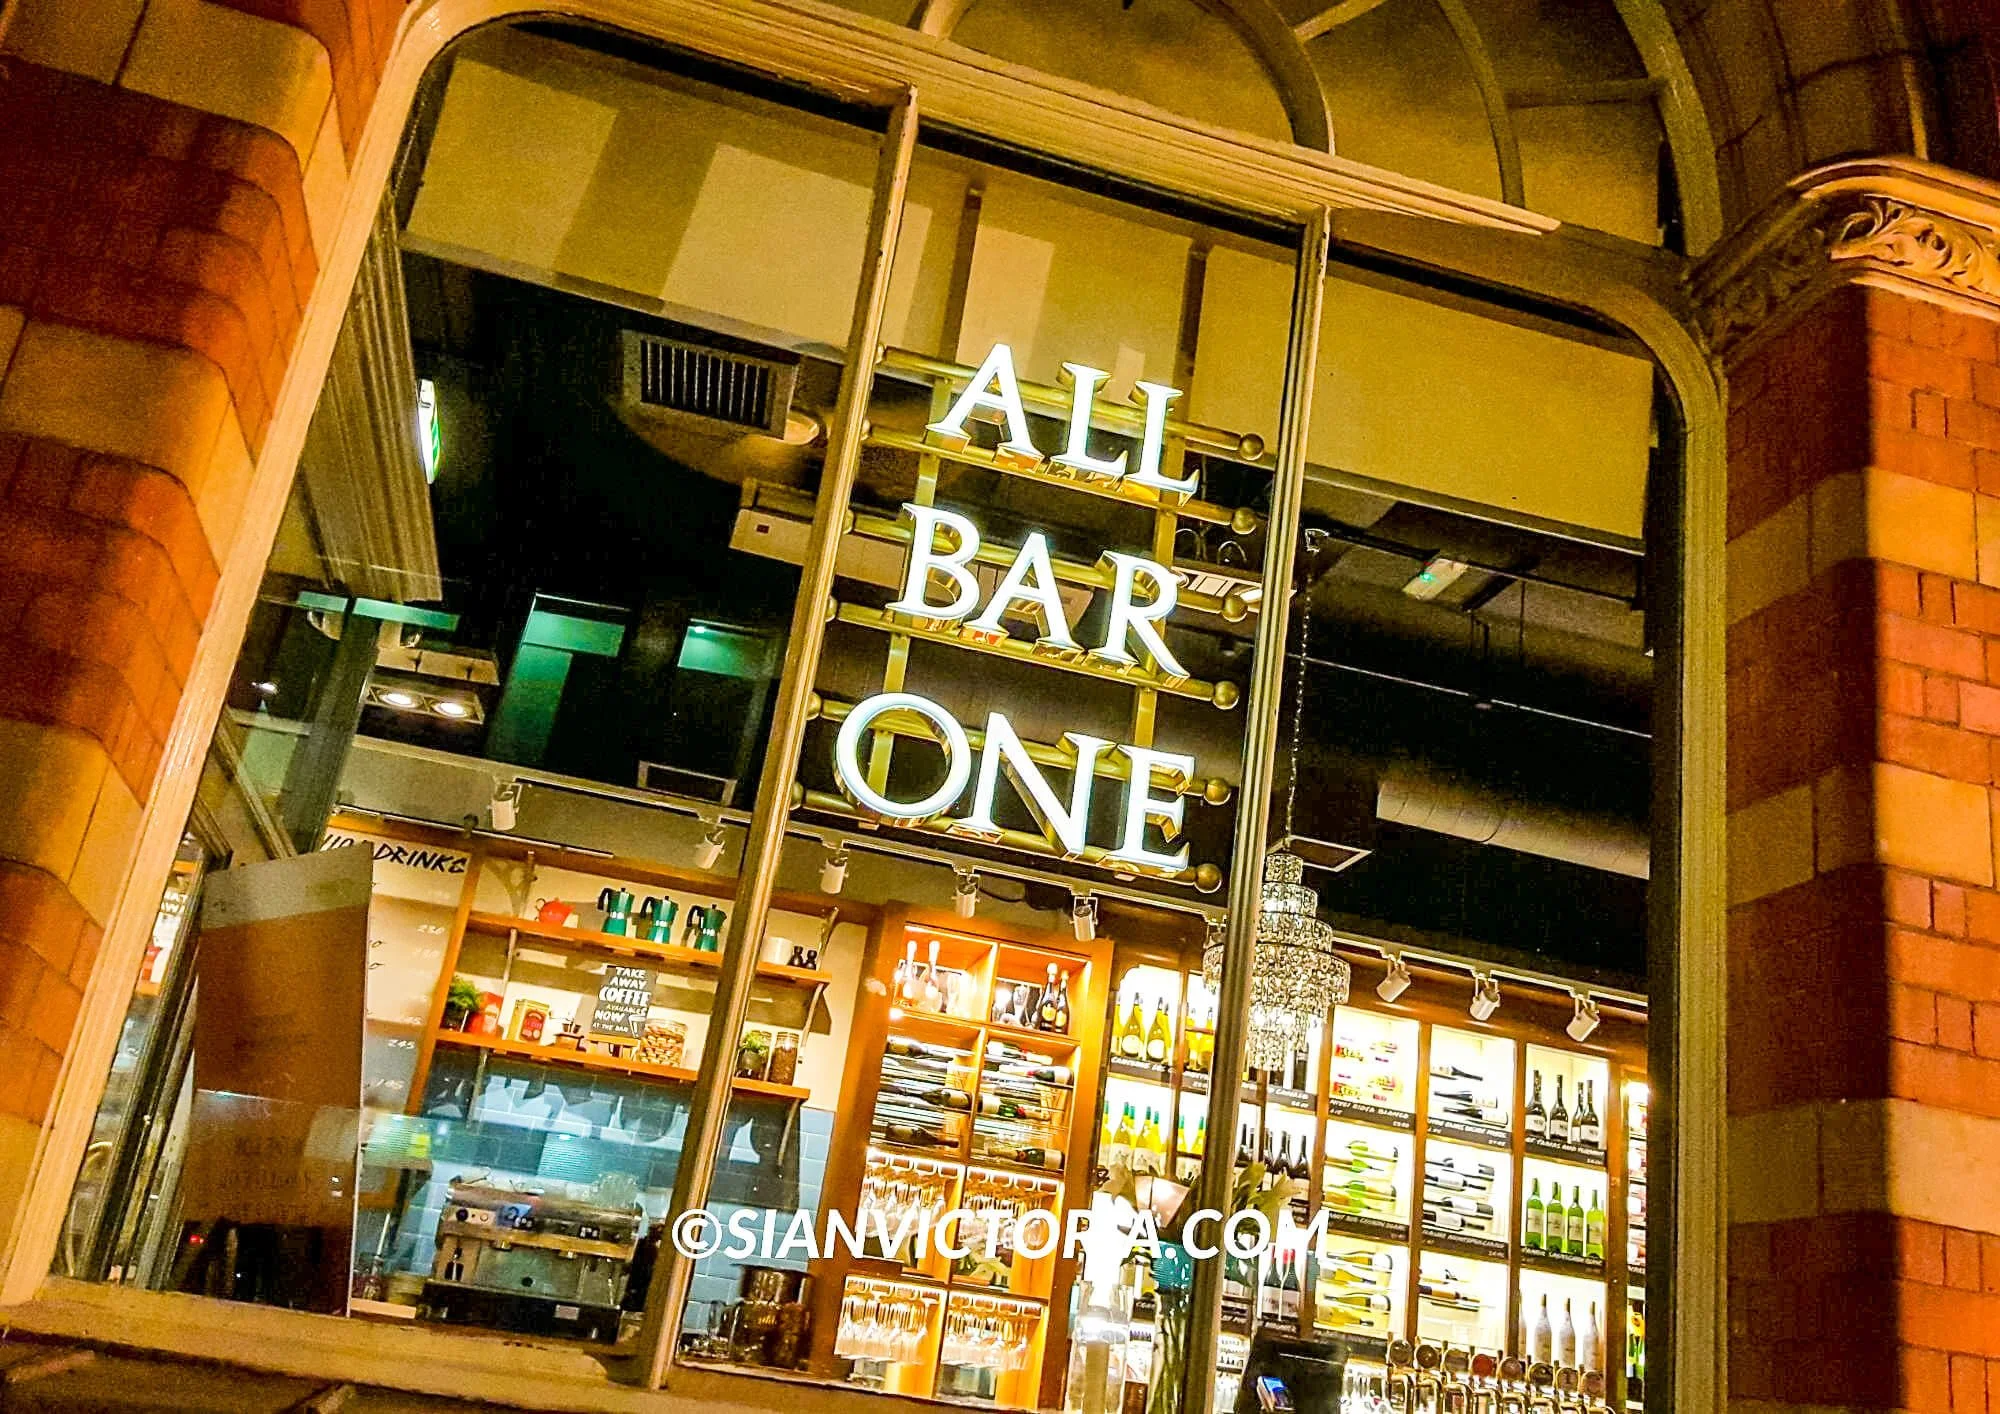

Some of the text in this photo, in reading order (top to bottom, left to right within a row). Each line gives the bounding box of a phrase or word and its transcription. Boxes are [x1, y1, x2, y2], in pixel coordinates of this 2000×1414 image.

[926, 343, 1199, 500] ALL
[885, 502, 1190, 680] BAR
[835, 692, 1196, 870] ONE
[615, 966, 646, 979] TAKE
[609, 976, 648, 990] AWAY
[598, 985, 652, 1008] COFFEE
[594, 1010, 625, 1023] NOW
[601, 1023, 614, 1031] THE
